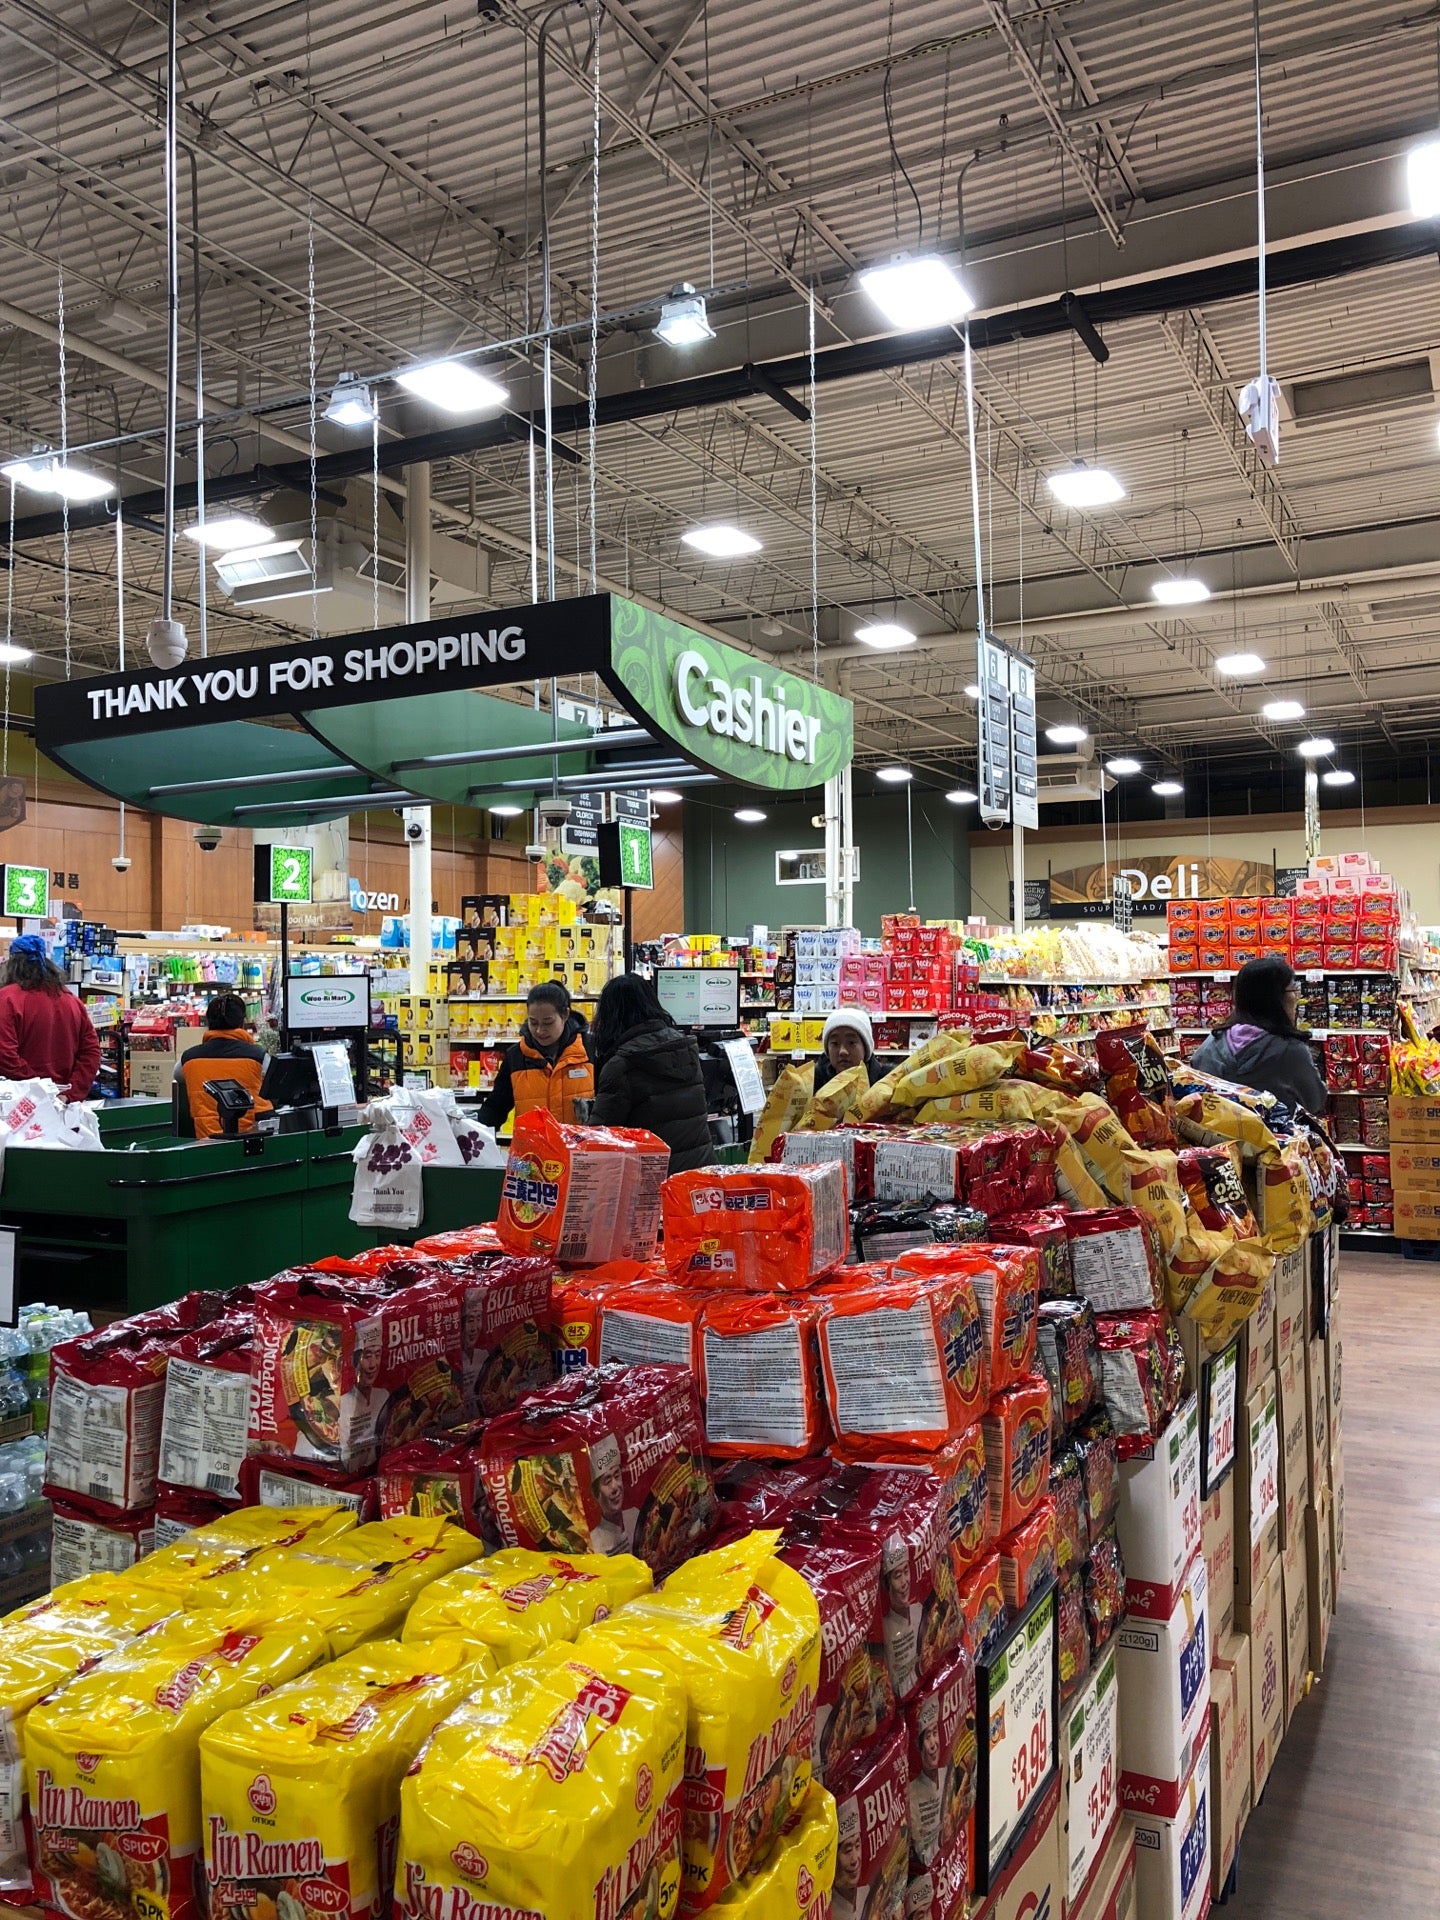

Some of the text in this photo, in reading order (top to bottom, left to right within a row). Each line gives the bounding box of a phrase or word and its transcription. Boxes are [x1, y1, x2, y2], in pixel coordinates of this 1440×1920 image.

[87, 626, 527, 720] THANK YOU FOR SHOPPING
[989, 653, 997, 678] 6
[1020, 670, 1027, 692] 6
[577, 710, 586, 724] 7
[673, 650, 822, 765] Cashier
[629, 838, 641, 874] 1
[282, 858, 302, 891] 2
[1120, 863, 1199, 900] Deli
[17, 877, 37, 907] 3
[350, 889, 399, 911] rozen
[305, 915, 324, 923] Mart
[978, 1091, 993, 1111] CHIP
[1148, 1185, 1170, 1201] HON
[487, 1285, 517, 1313] BUL
[1216, 1288, 1239, 1304] HONEY
[388, 1314, 424, 1349] BUL
[567, 1325, 586, 1337] 원조
[387, 1336, 446, 1371] JJAMPPONG
[260, 1336, 281, 1434] JJAMPPONG
[624, 1417, 659, 1463] BUL
[821, 1604, 856, 1658] BUL
[1011, 1708, 1047, 1812] $3.99
[35, 1769, 141, 1831] Jin Ramen
[1088, 1754, 1112, 1840] $5.99
[251, 1816, 276, 1827] OTTOGI
[122, 1838, 161, 1855] SPICY
[208, 1815, 322, 1882] Jin Ramen
[219, 1881, 257, 1907] 진라면
[305, 1884, 342, 1907] SPICY
[404, 1860, 444, 1920] Jin
